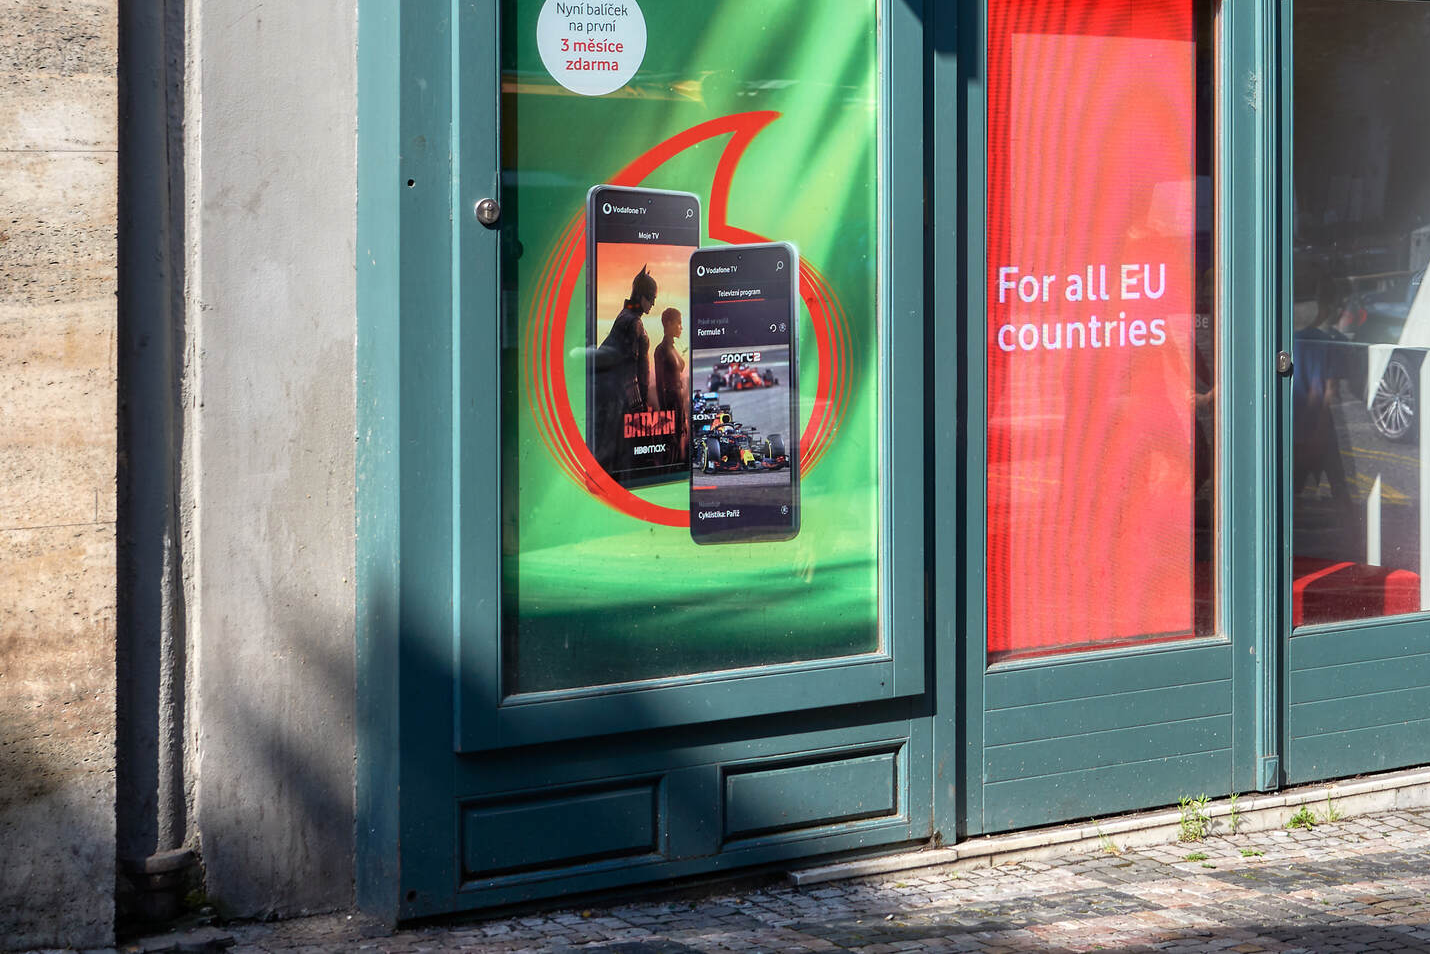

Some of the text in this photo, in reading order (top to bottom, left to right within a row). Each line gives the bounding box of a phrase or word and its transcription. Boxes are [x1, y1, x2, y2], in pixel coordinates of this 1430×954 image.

[556, 1, 628, 18] Nyní balíček
[569, 20, 616, 34] na první
[560, 38, 624, 53] 3 měsíce
[565, 58, 619, 71] zdarma
[612, 204, 646, 216] Vodafone TV
[649, 232, 659, 240] TV
[706, 265, 738, 275] Vodafone TV
[998, 263, 1166, 304] For all EU
[741, 288, 761, 298] program
[698, 326, 725, 337] Formule 1
[997, 311, 1167, 352] countries
[623, 410, 676, 439] BATMAN
